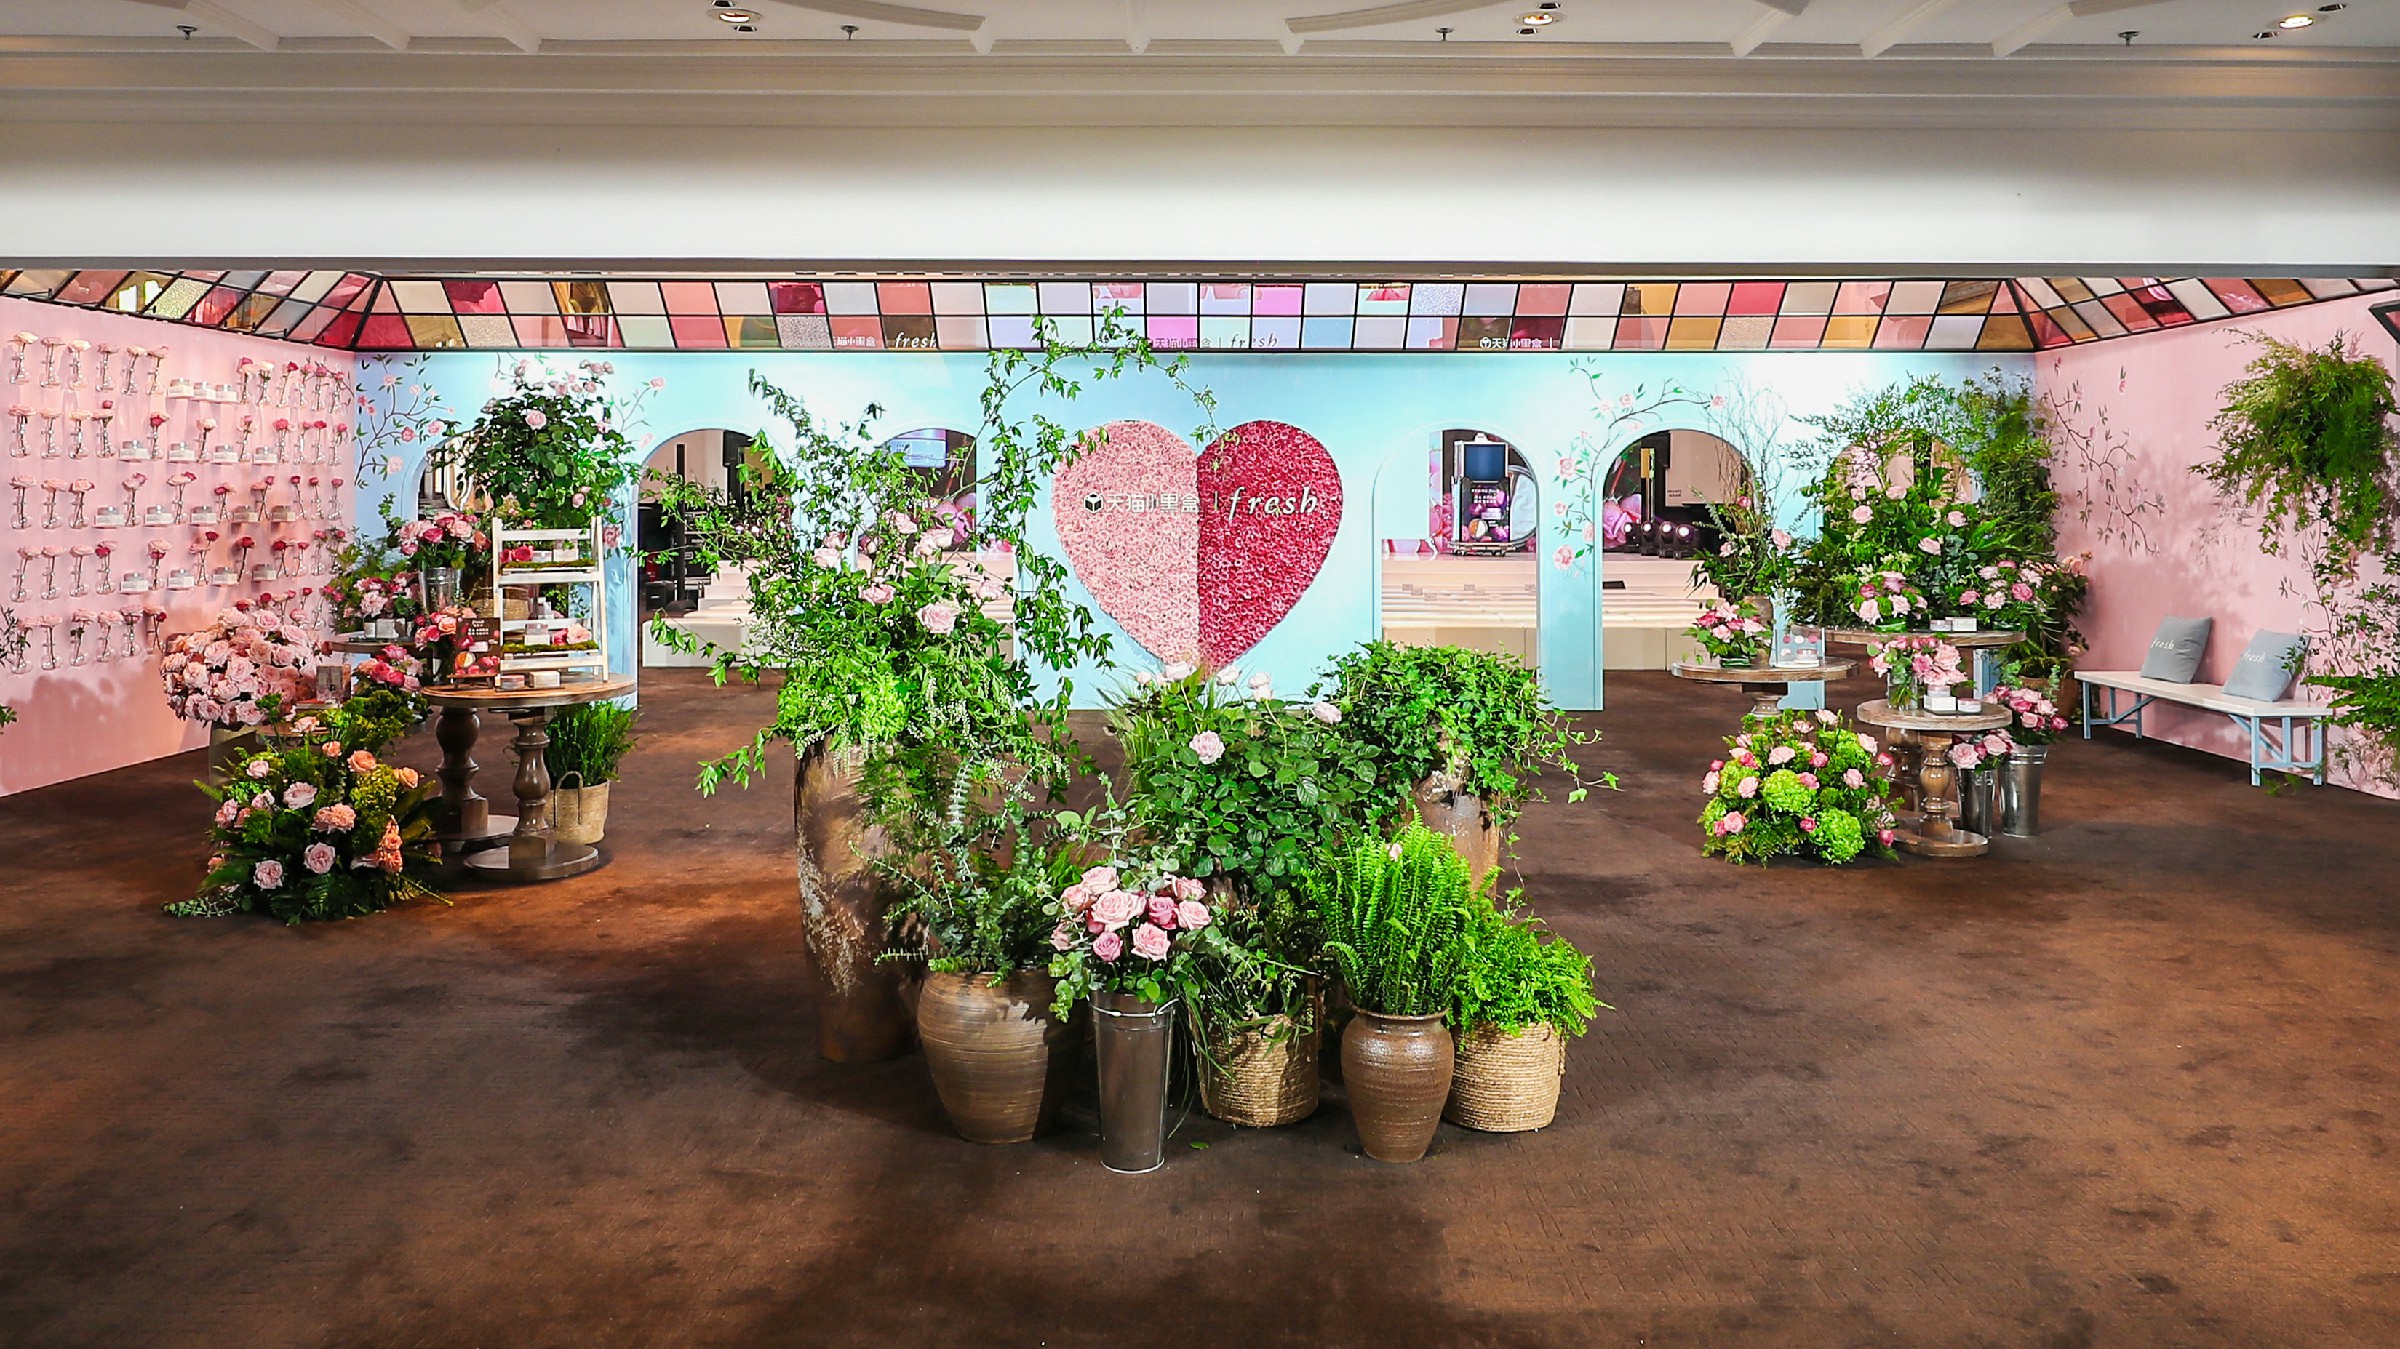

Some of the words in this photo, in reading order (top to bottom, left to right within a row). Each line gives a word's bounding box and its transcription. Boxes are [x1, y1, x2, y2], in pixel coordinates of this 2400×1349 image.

[895, 332, 937, 348] fresh
[1106, 493, 1199, 513] 天猫小黑盒
[1228, 486, 1318, 523] fresh
[2150, 637, 2175, 650] fresh
[2241, 649, 2266, 663] fresh
